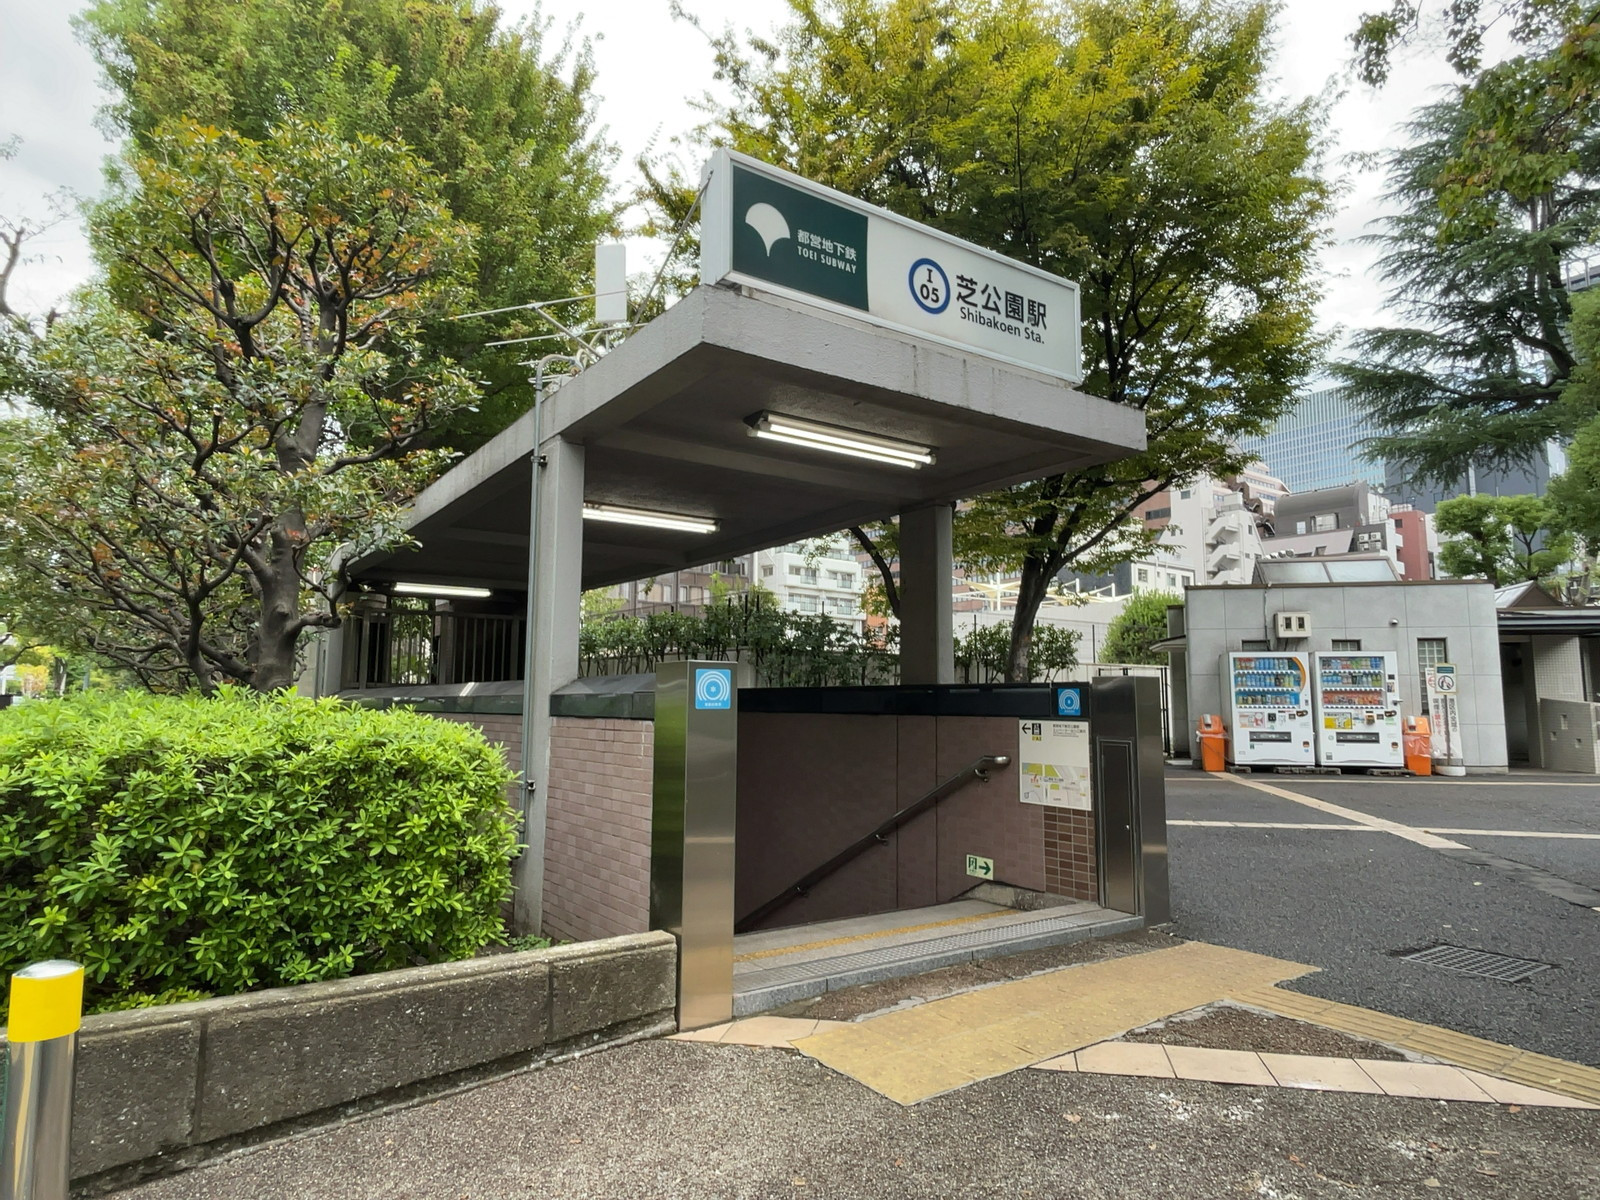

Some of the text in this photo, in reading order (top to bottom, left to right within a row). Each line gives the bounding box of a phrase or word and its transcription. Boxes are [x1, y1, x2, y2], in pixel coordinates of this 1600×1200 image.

[797, 229, 857, 262] 都営地下鉄
[797, 245, 857, 274] TOEI SUBWAY
[926, 267, 934, 284] I
[919, 283, 940, 304] 05
[955, 274, 1047, 331] 芝公園駅
[959, 306, 1046, 345] Shibakoen Sta.
